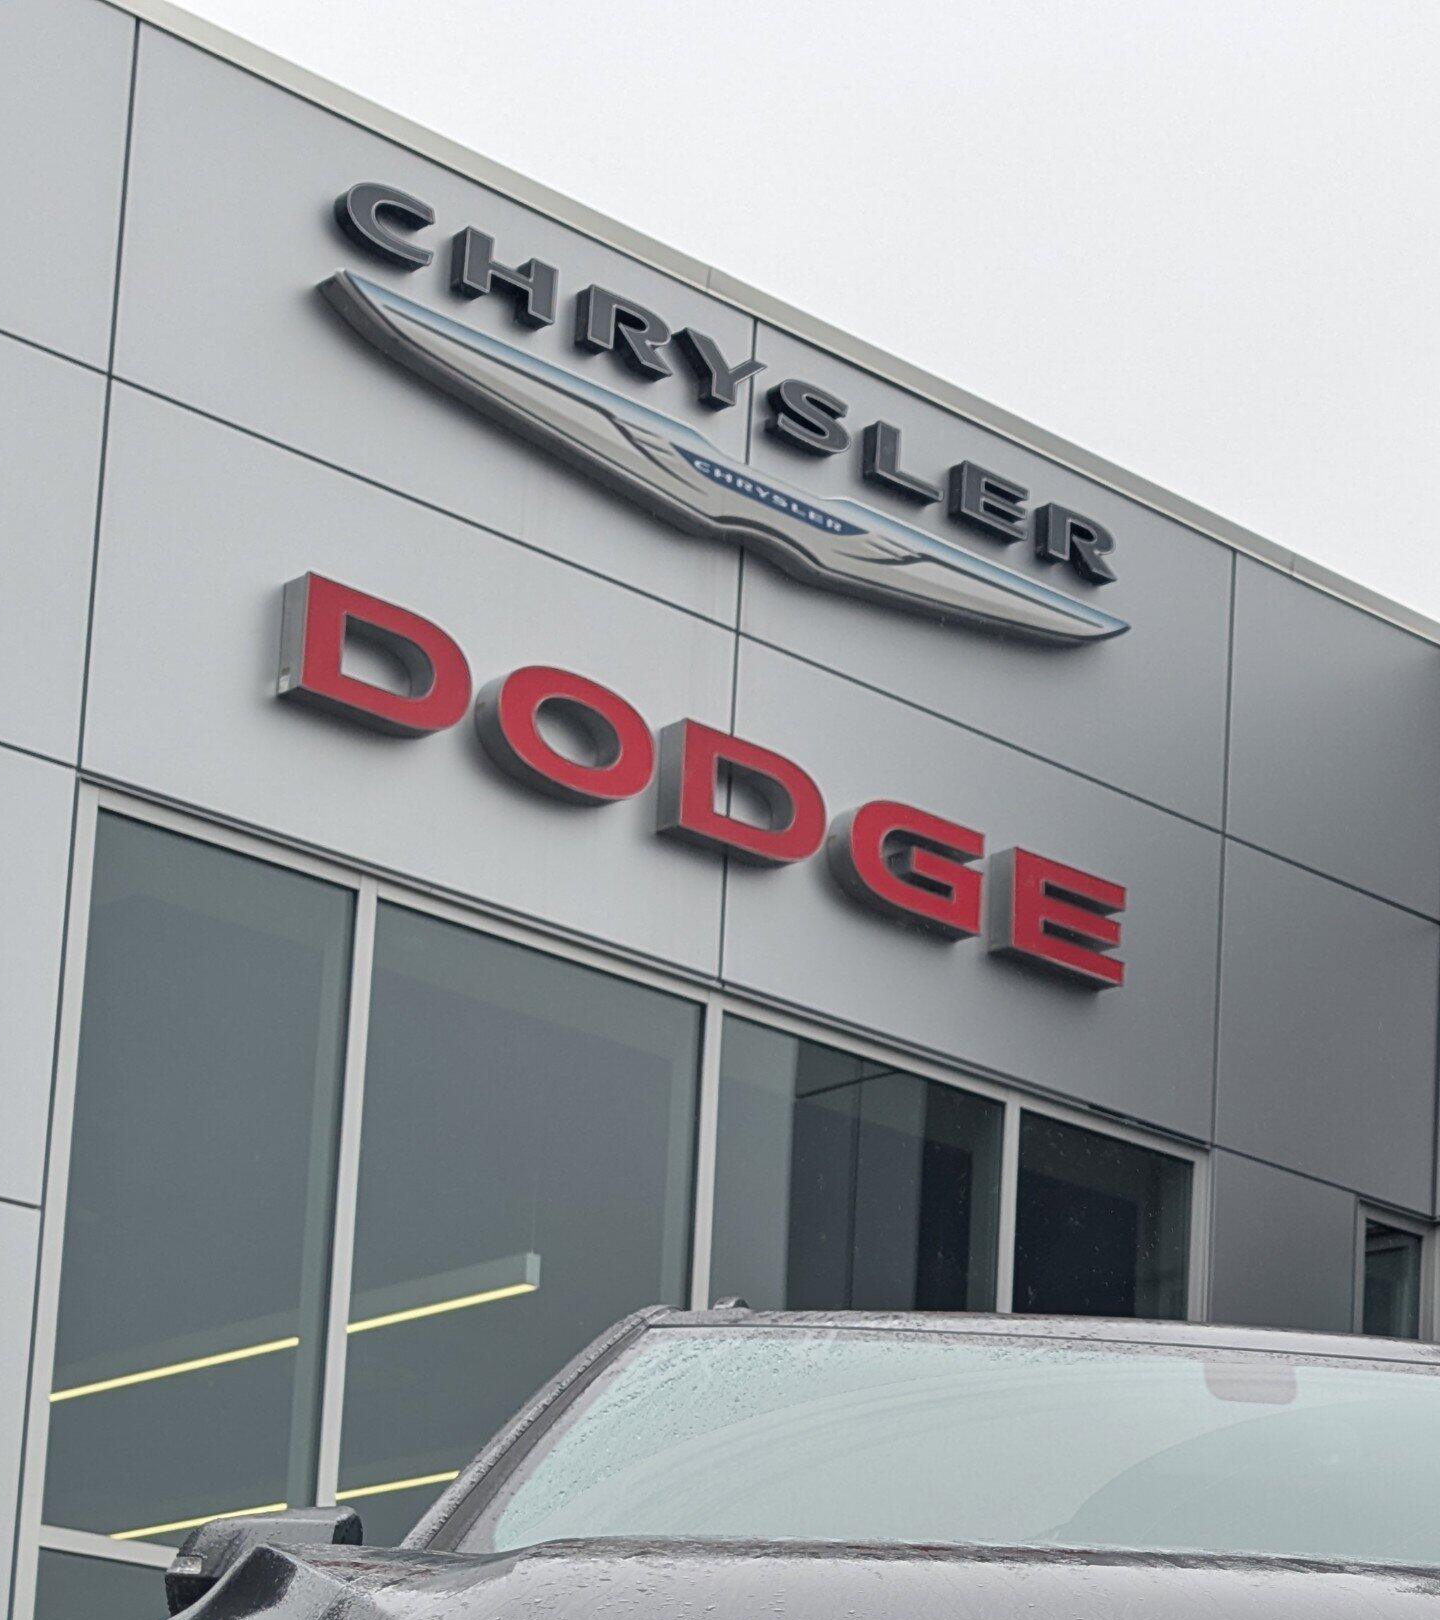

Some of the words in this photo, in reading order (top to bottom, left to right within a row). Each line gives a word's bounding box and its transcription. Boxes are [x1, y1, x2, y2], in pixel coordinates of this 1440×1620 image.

[334, 182, 1117, 586] CHRYSLER
[694, 460, 842, 532] CHRYSLER
[276, 571, 1127, 989] DODGE
